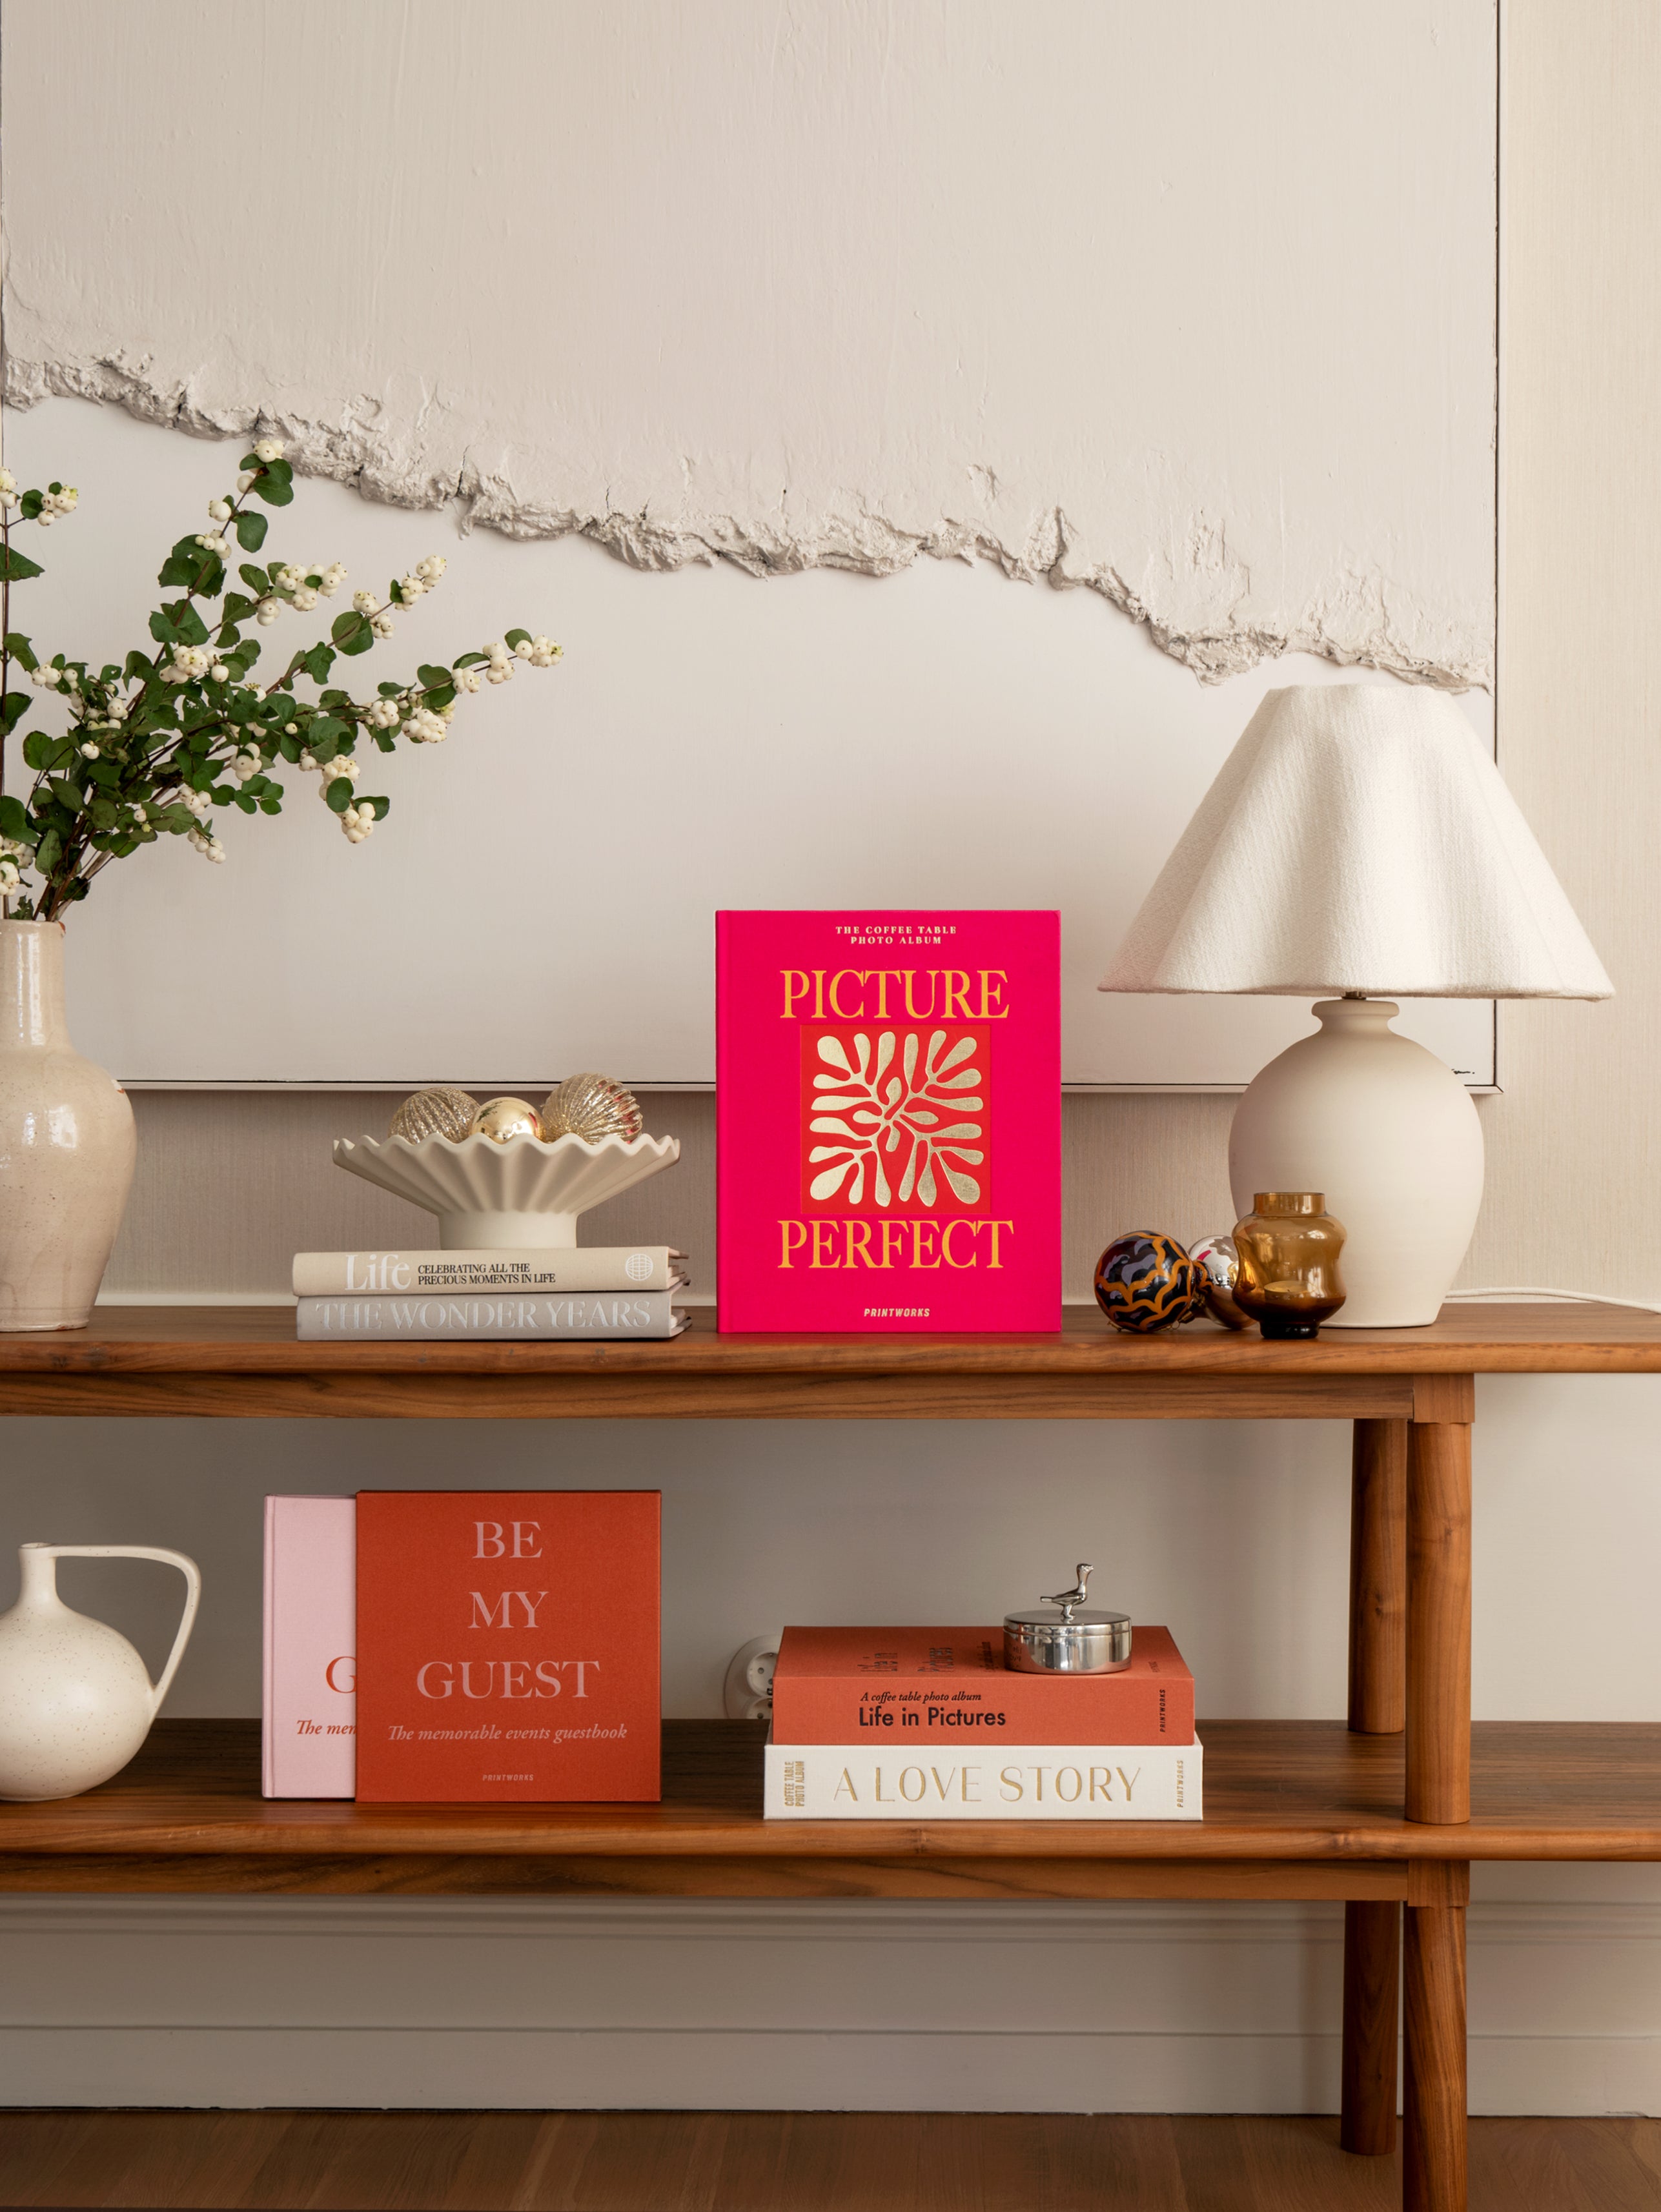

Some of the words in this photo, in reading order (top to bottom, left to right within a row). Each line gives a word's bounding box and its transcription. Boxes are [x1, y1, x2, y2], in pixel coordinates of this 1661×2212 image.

[780, 969, 1009, 1019] PICTURE
[778, 1220, 1014, 1268] PERFECT
[344, 1253, 411, 1290] Life
[418, 1264, 485, 1274] CELEBRATING
[489, 1264, 507, 1273] ALL
[509, 1264, 529, 1272] THE
[418, 1275, 467, 1284] PRECIOUS
[469, 1274, 519, 1284] MOMENTS
[522, 1274, 531, 1283] IN
[535, 1273, 555, 1283] LIFE
[316, 1302, 383, 1330] THE
[390, 1300, 540, 1330] WONDER
[545, 1300, 651, 1328] YEARS
[864, 1308, 930, 1317] PRINTWORKS
[473, 1522, 542, 1558] BE
[468, 1592, 549, 1628] MY
[417, 1661, 600, 1699] GUEST
[861, 1692, 868, 1701] A
[871, 1692, 896, 1704] coffee
[899, 1691, 921, 1701] table
[922, 1691, 949, 1704] photo
[952, 1691, 981, 1701] album
[297, 1720, 322, 1734] The
[859, 1707, 894, 1726] Life
[902, 1707, 919, 1726] in
[928, 1707, 1006, 1725] Pictures
[389, 1725, 414, 1740] The
[418, 1725, 502, 1740] memorable
[506, 1728, 551, 1739] events
[555, 1723, 627, 1743] guestbook
[784, 1761, 794, 1781] TABLE
[795, 1761, 804, 1783] ALBUM
[784, 1783, 794, 1806] COFFEE
[834, 1767, 858, 1801] A
[876, 1767, 981, 1801] LOVE
[1001, 1767, 1141, 1801] STORY
[795, 1785, 805, 1807] PHOTO
